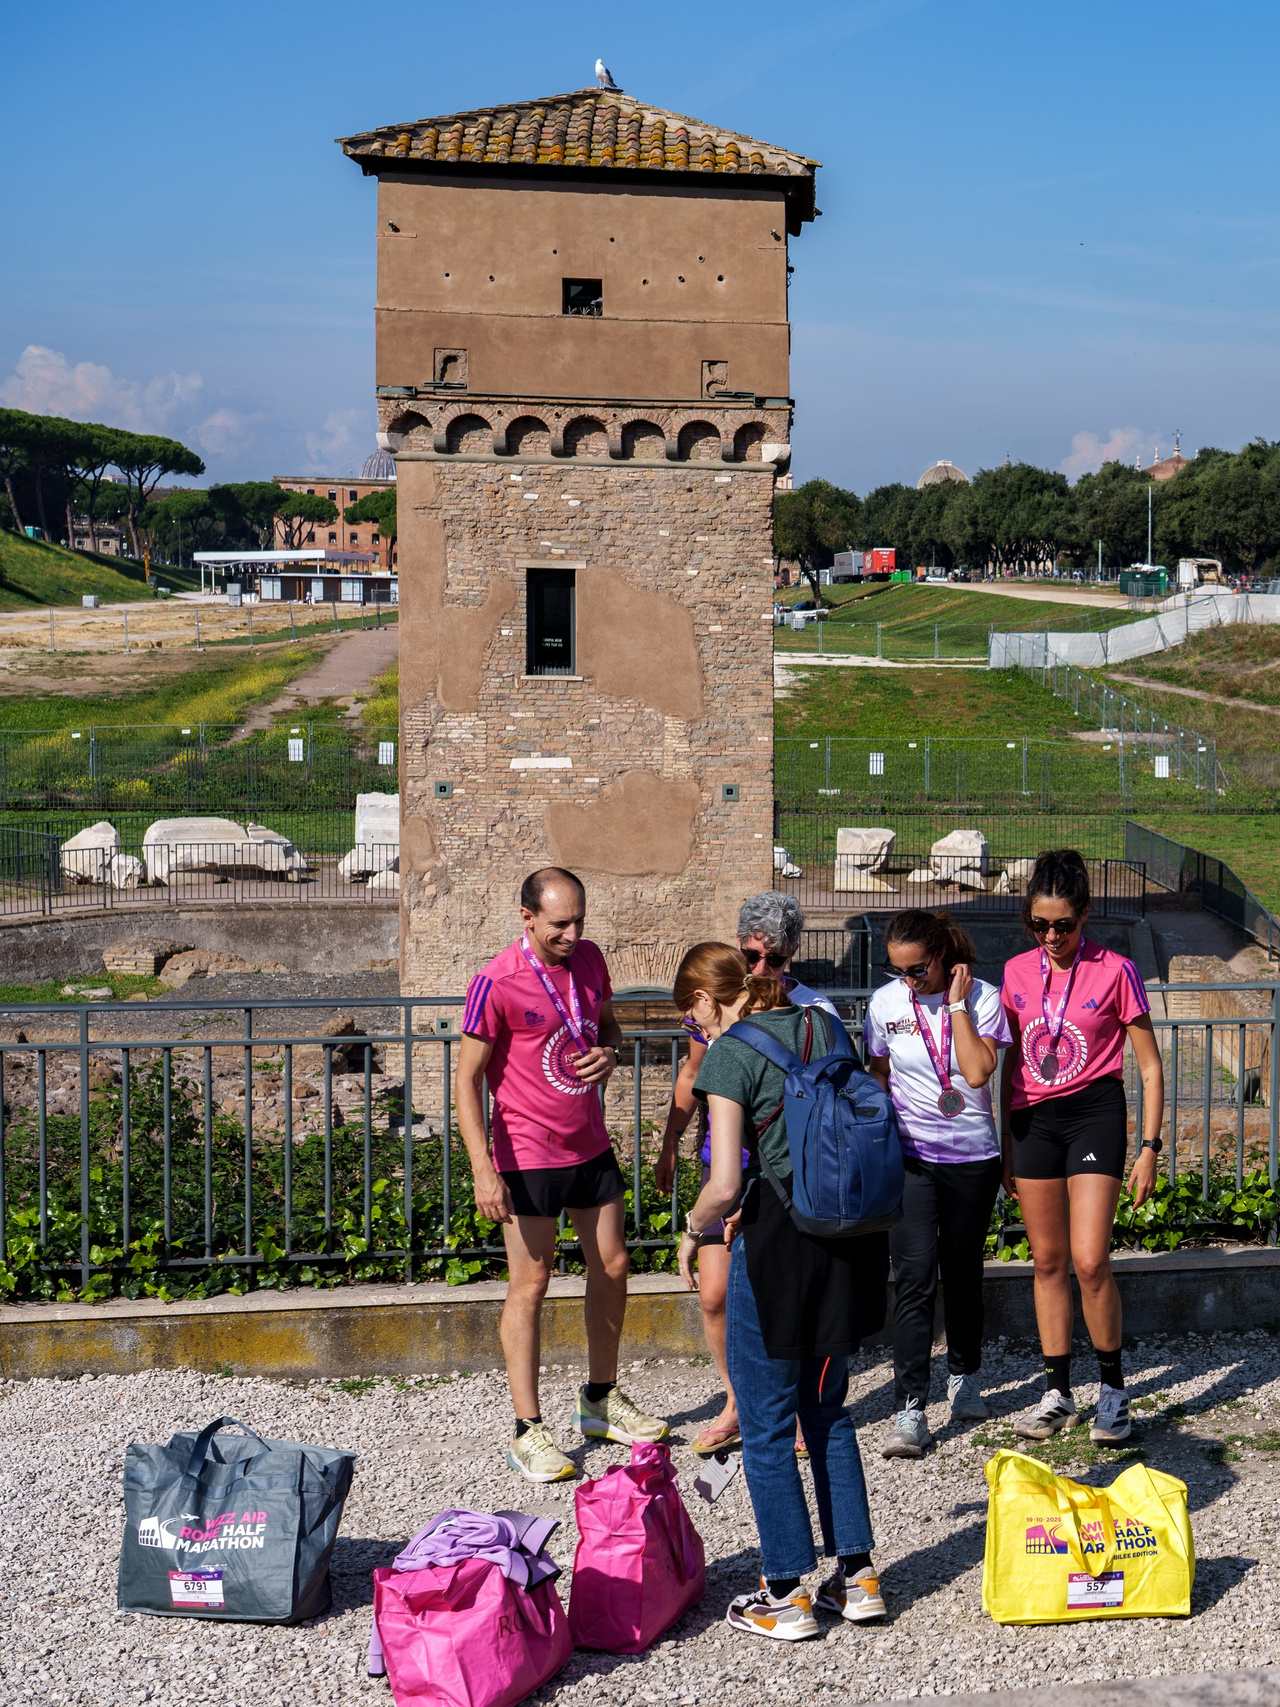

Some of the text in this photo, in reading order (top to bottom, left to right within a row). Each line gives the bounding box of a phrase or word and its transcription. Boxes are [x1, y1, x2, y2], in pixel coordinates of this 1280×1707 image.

[239, 1511, 268, 1524] AIR
[1082, 1518, 1121, 1533] WIZ
[1115, 1526, 1152, 1538] HALF
[179, 1523, 267, 1542] ROME HALF
[175, 1536, 265, 1554] MARATHON
[1071, 1536, 1157, 1554] ARTHON
[1113, 1550, 1158, 1560] BILEE EDITION
[184, 1581, 207, 1591] 6791
[1086, 1581, 1106, 1591] 557
